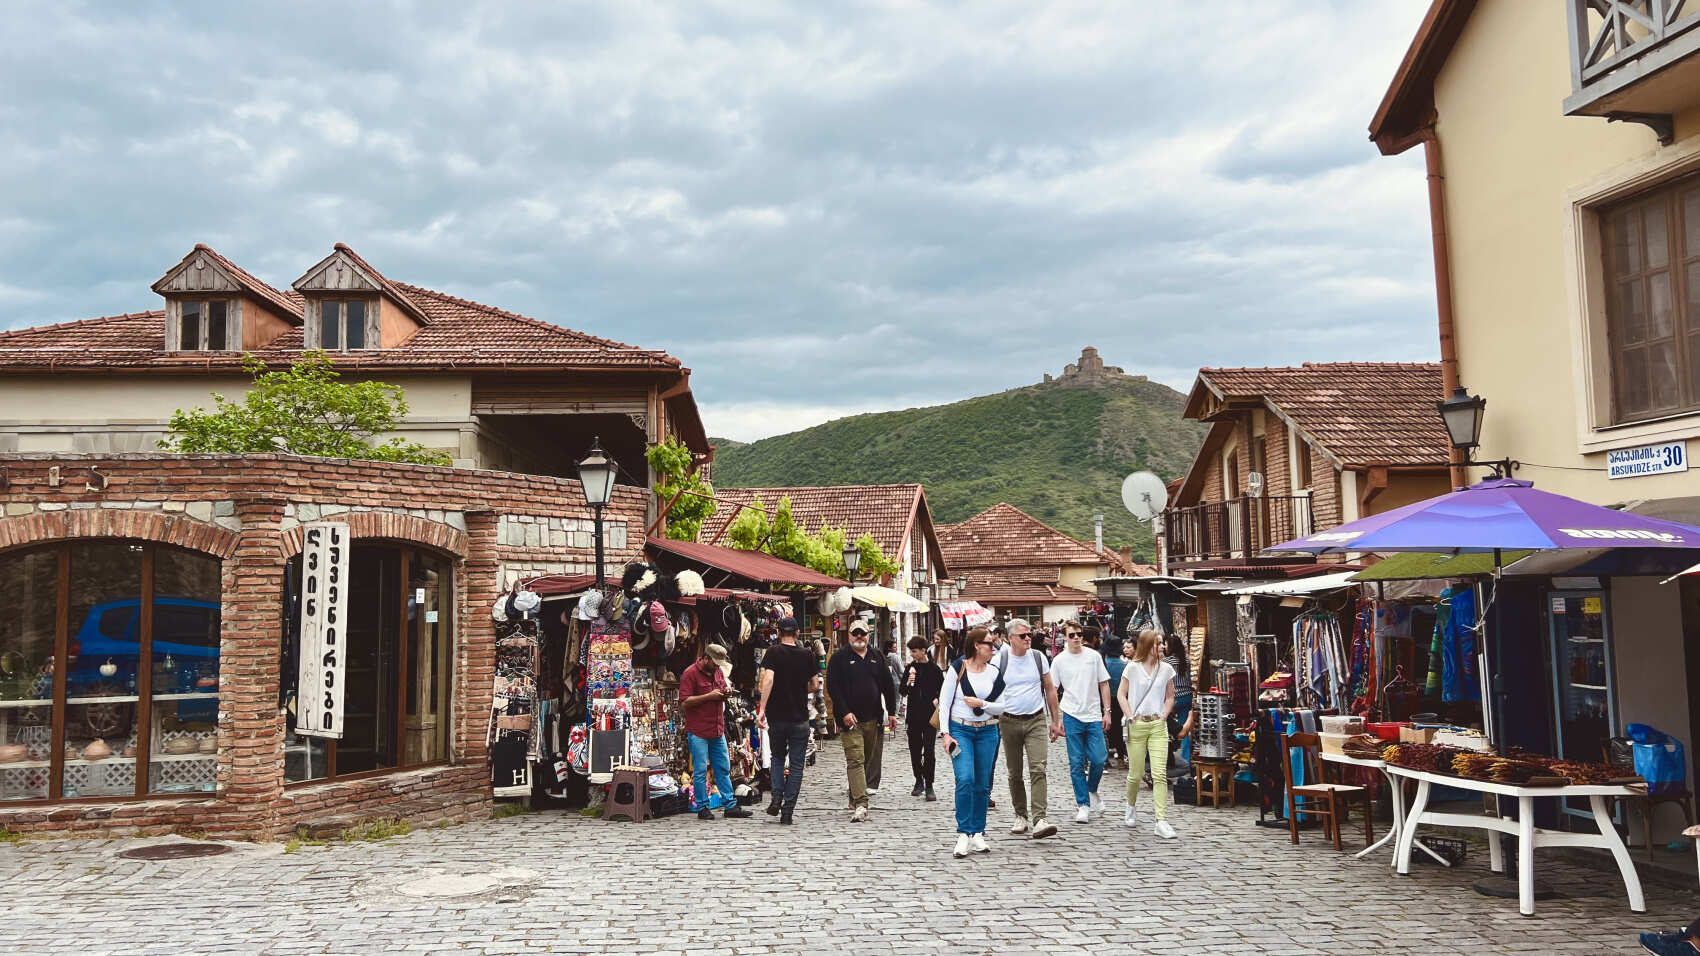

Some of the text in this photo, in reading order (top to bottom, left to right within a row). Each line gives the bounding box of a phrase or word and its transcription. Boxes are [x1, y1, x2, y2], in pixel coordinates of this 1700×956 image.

[1663, 445, 1682, 467] 30
[1611, 462, 1651, 476] ARSUKIDZE
[322, 527, 341, 730] სუვენირები
